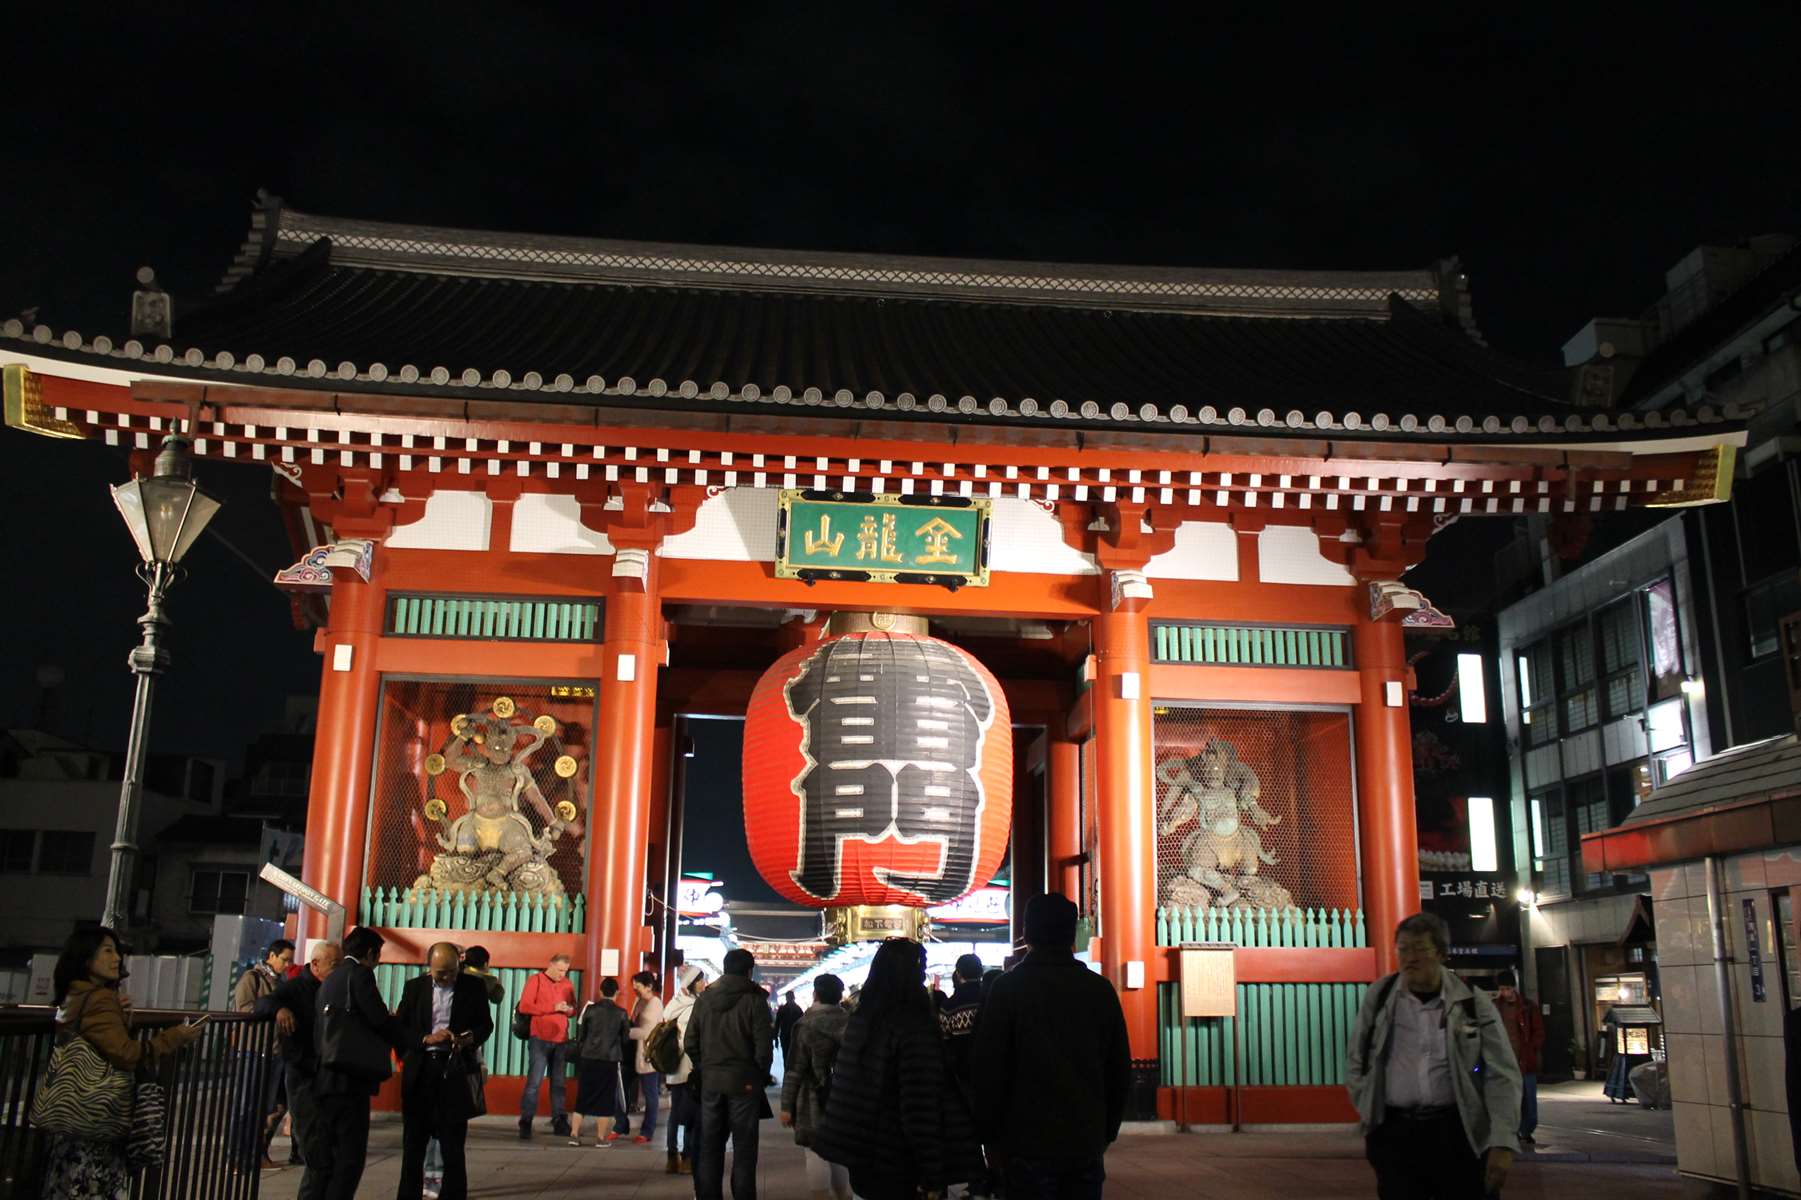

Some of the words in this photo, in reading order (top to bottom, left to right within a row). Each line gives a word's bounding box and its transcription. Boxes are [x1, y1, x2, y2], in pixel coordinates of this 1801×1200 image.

[784, 636, 992, 902] 雷門
[1439, 880, 1506, 899] 工場直送
